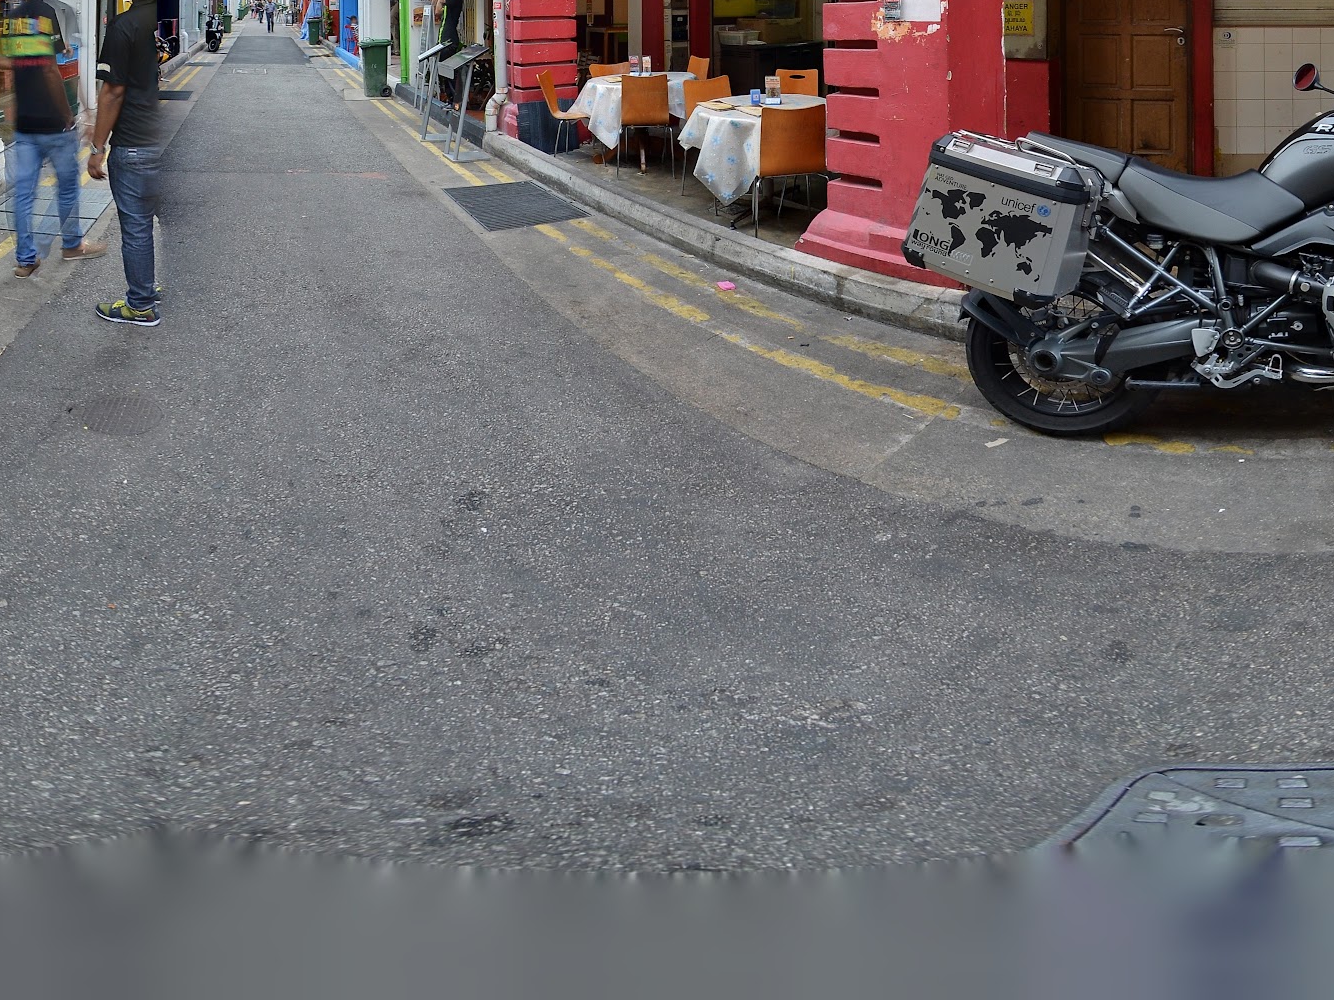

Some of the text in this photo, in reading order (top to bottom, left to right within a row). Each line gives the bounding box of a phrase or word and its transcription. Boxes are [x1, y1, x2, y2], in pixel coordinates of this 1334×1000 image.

[935, 176, 967, 191] ADVENTURE
[1001, 196, 1036, 213] unicef
[912, 228, 949, 250] LONG
